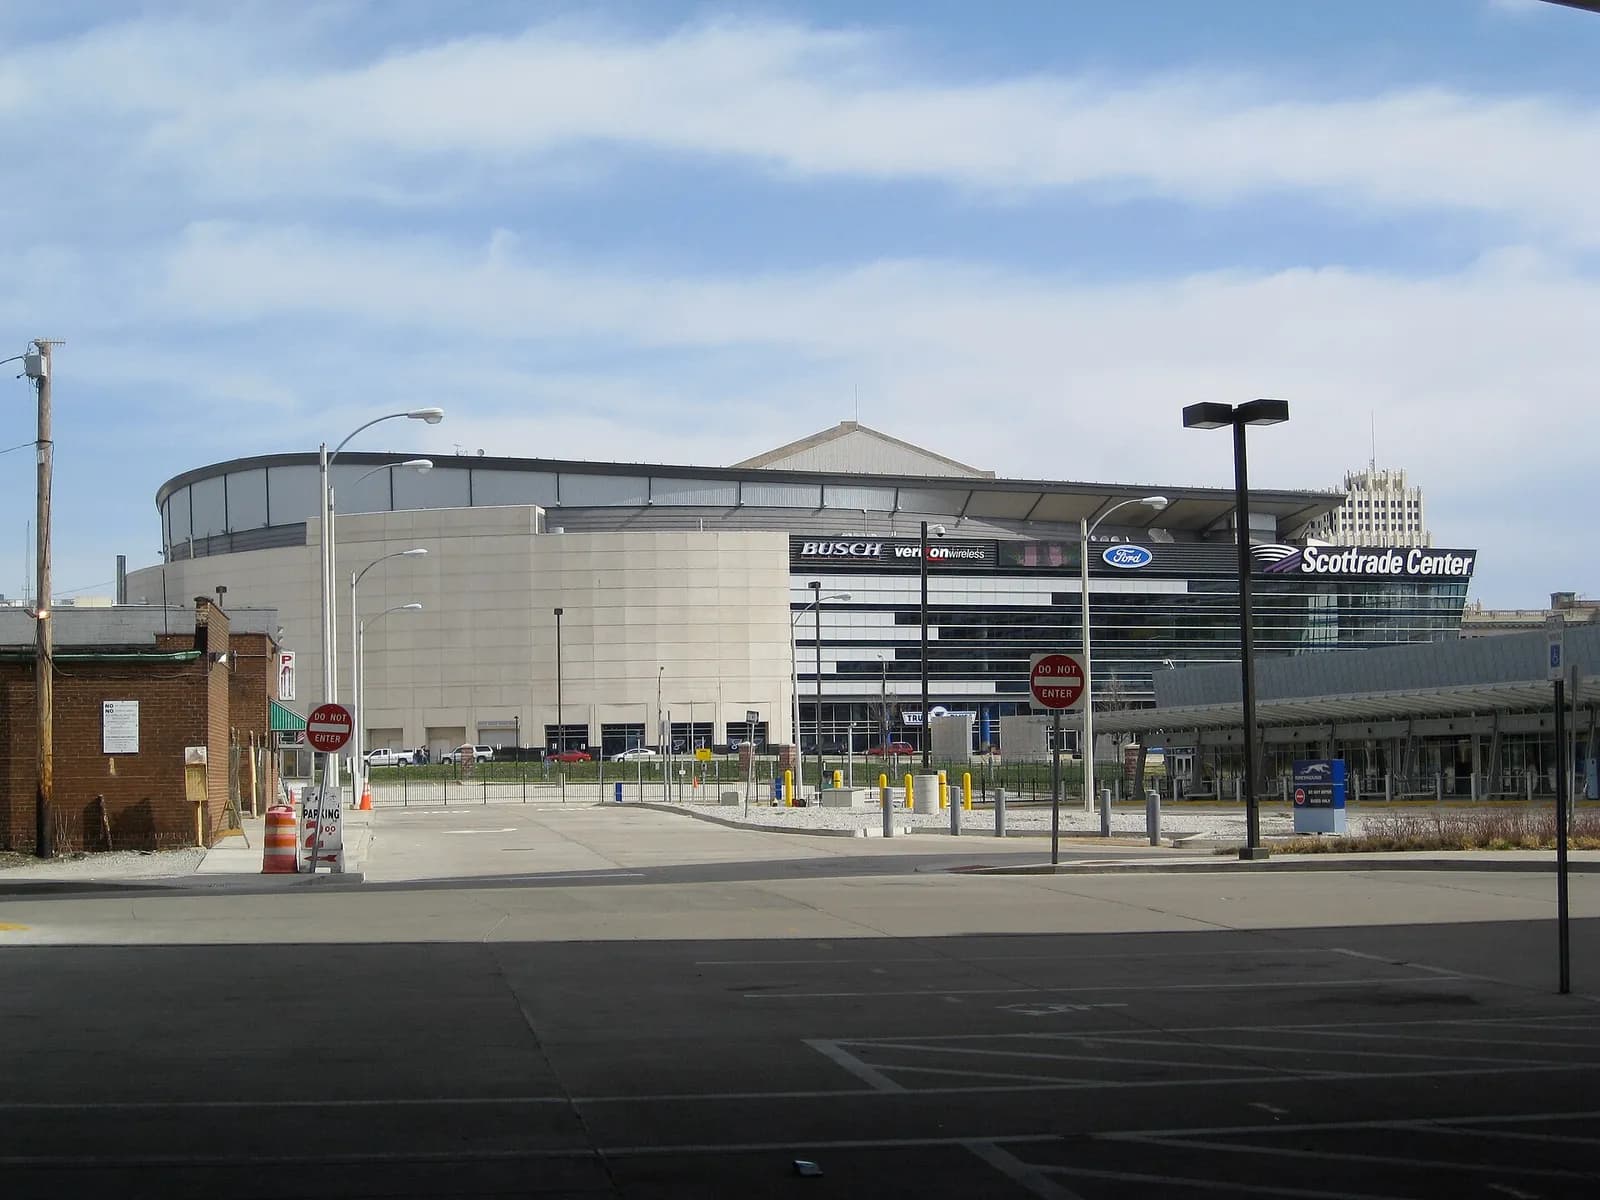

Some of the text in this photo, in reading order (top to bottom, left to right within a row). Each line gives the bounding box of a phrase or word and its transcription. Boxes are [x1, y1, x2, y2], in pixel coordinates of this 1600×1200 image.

[800, 542, 882, 556] BUSCH
[949, 547, 985, 559] wireless
[1113, 548, 1142, 563] Ford
[1301, 546, 1473, 575] Scottrade Center
[281, 655, 292, 665] P
[1038, 664, 1077, 674] DO NOT
[1042, 688, 1073, 698] ENTER
[314, 711, 347, 722] DO NOT
[907, 714, 926, 722] TRU
[314, 733, 341, 743] ENTER
